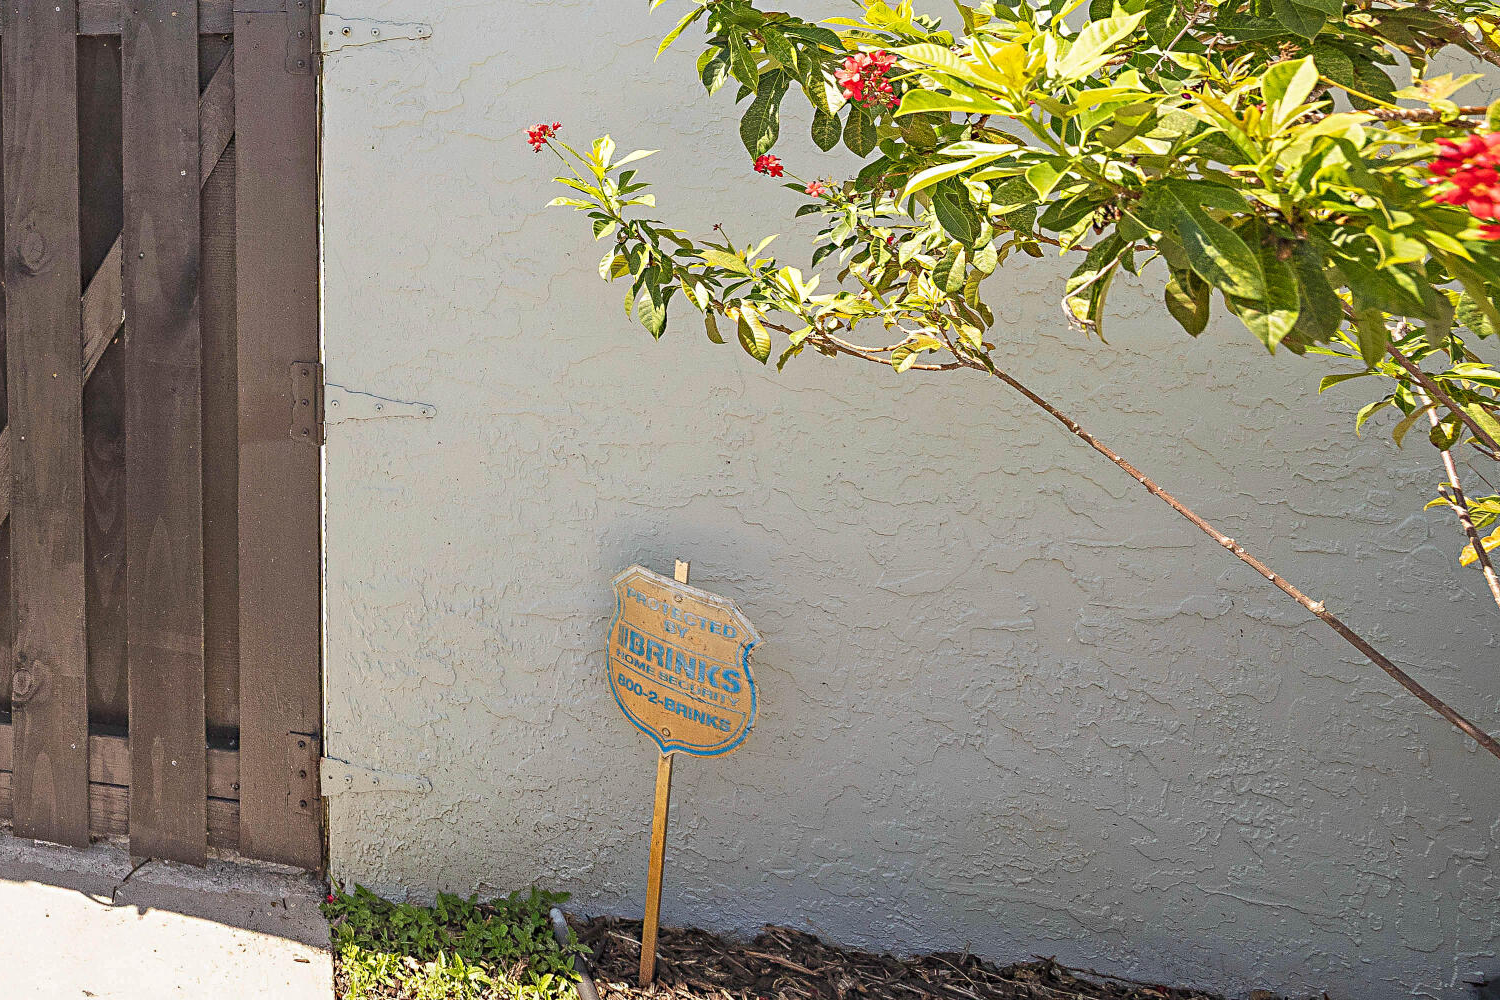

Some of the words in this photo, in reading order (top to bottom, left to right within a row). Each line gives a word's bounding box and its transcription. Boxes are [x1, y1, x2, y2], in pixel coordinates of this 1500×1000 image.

[627, 586, 738, 638] PROTECTED
[664, 620, 690, 638] BY
[616, 649, 655, 676] HOME
[659, 673, 740, 706] SECURITY
[629, 631, 742, 693] BRINKS
[617, 673, 732, 732] 800-2-BRINKS
